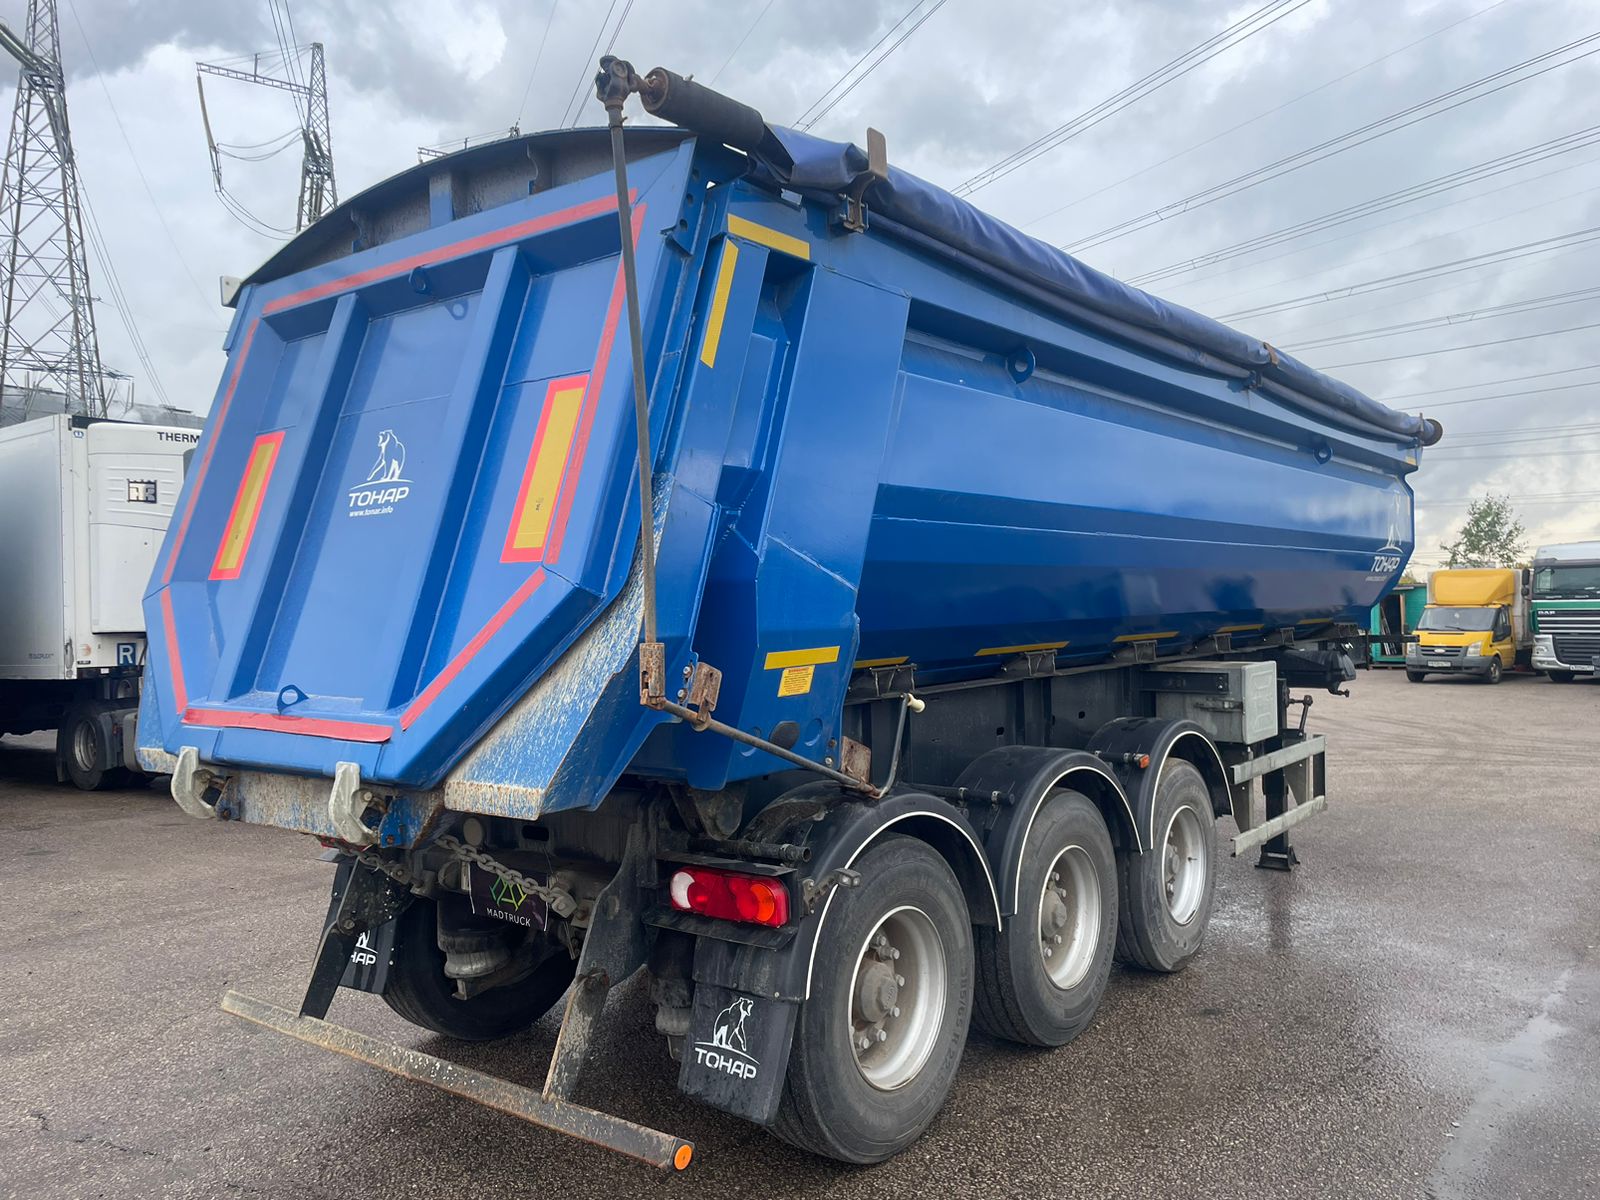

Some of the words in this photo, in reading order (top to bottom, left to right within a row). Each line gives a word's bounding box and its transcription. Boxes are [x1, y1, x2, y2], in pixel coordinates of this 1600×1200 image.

[157, 432, 200, 443] THERM
[349, 487, 409, 507] ТОНАР
[1371, 556, 1400, 572] ТОНАР
[119, 644, 134, 664] R
[487, 907, 531, 927] MADTRUCK
[695, 1047, 757, 1079] ТОНАР
